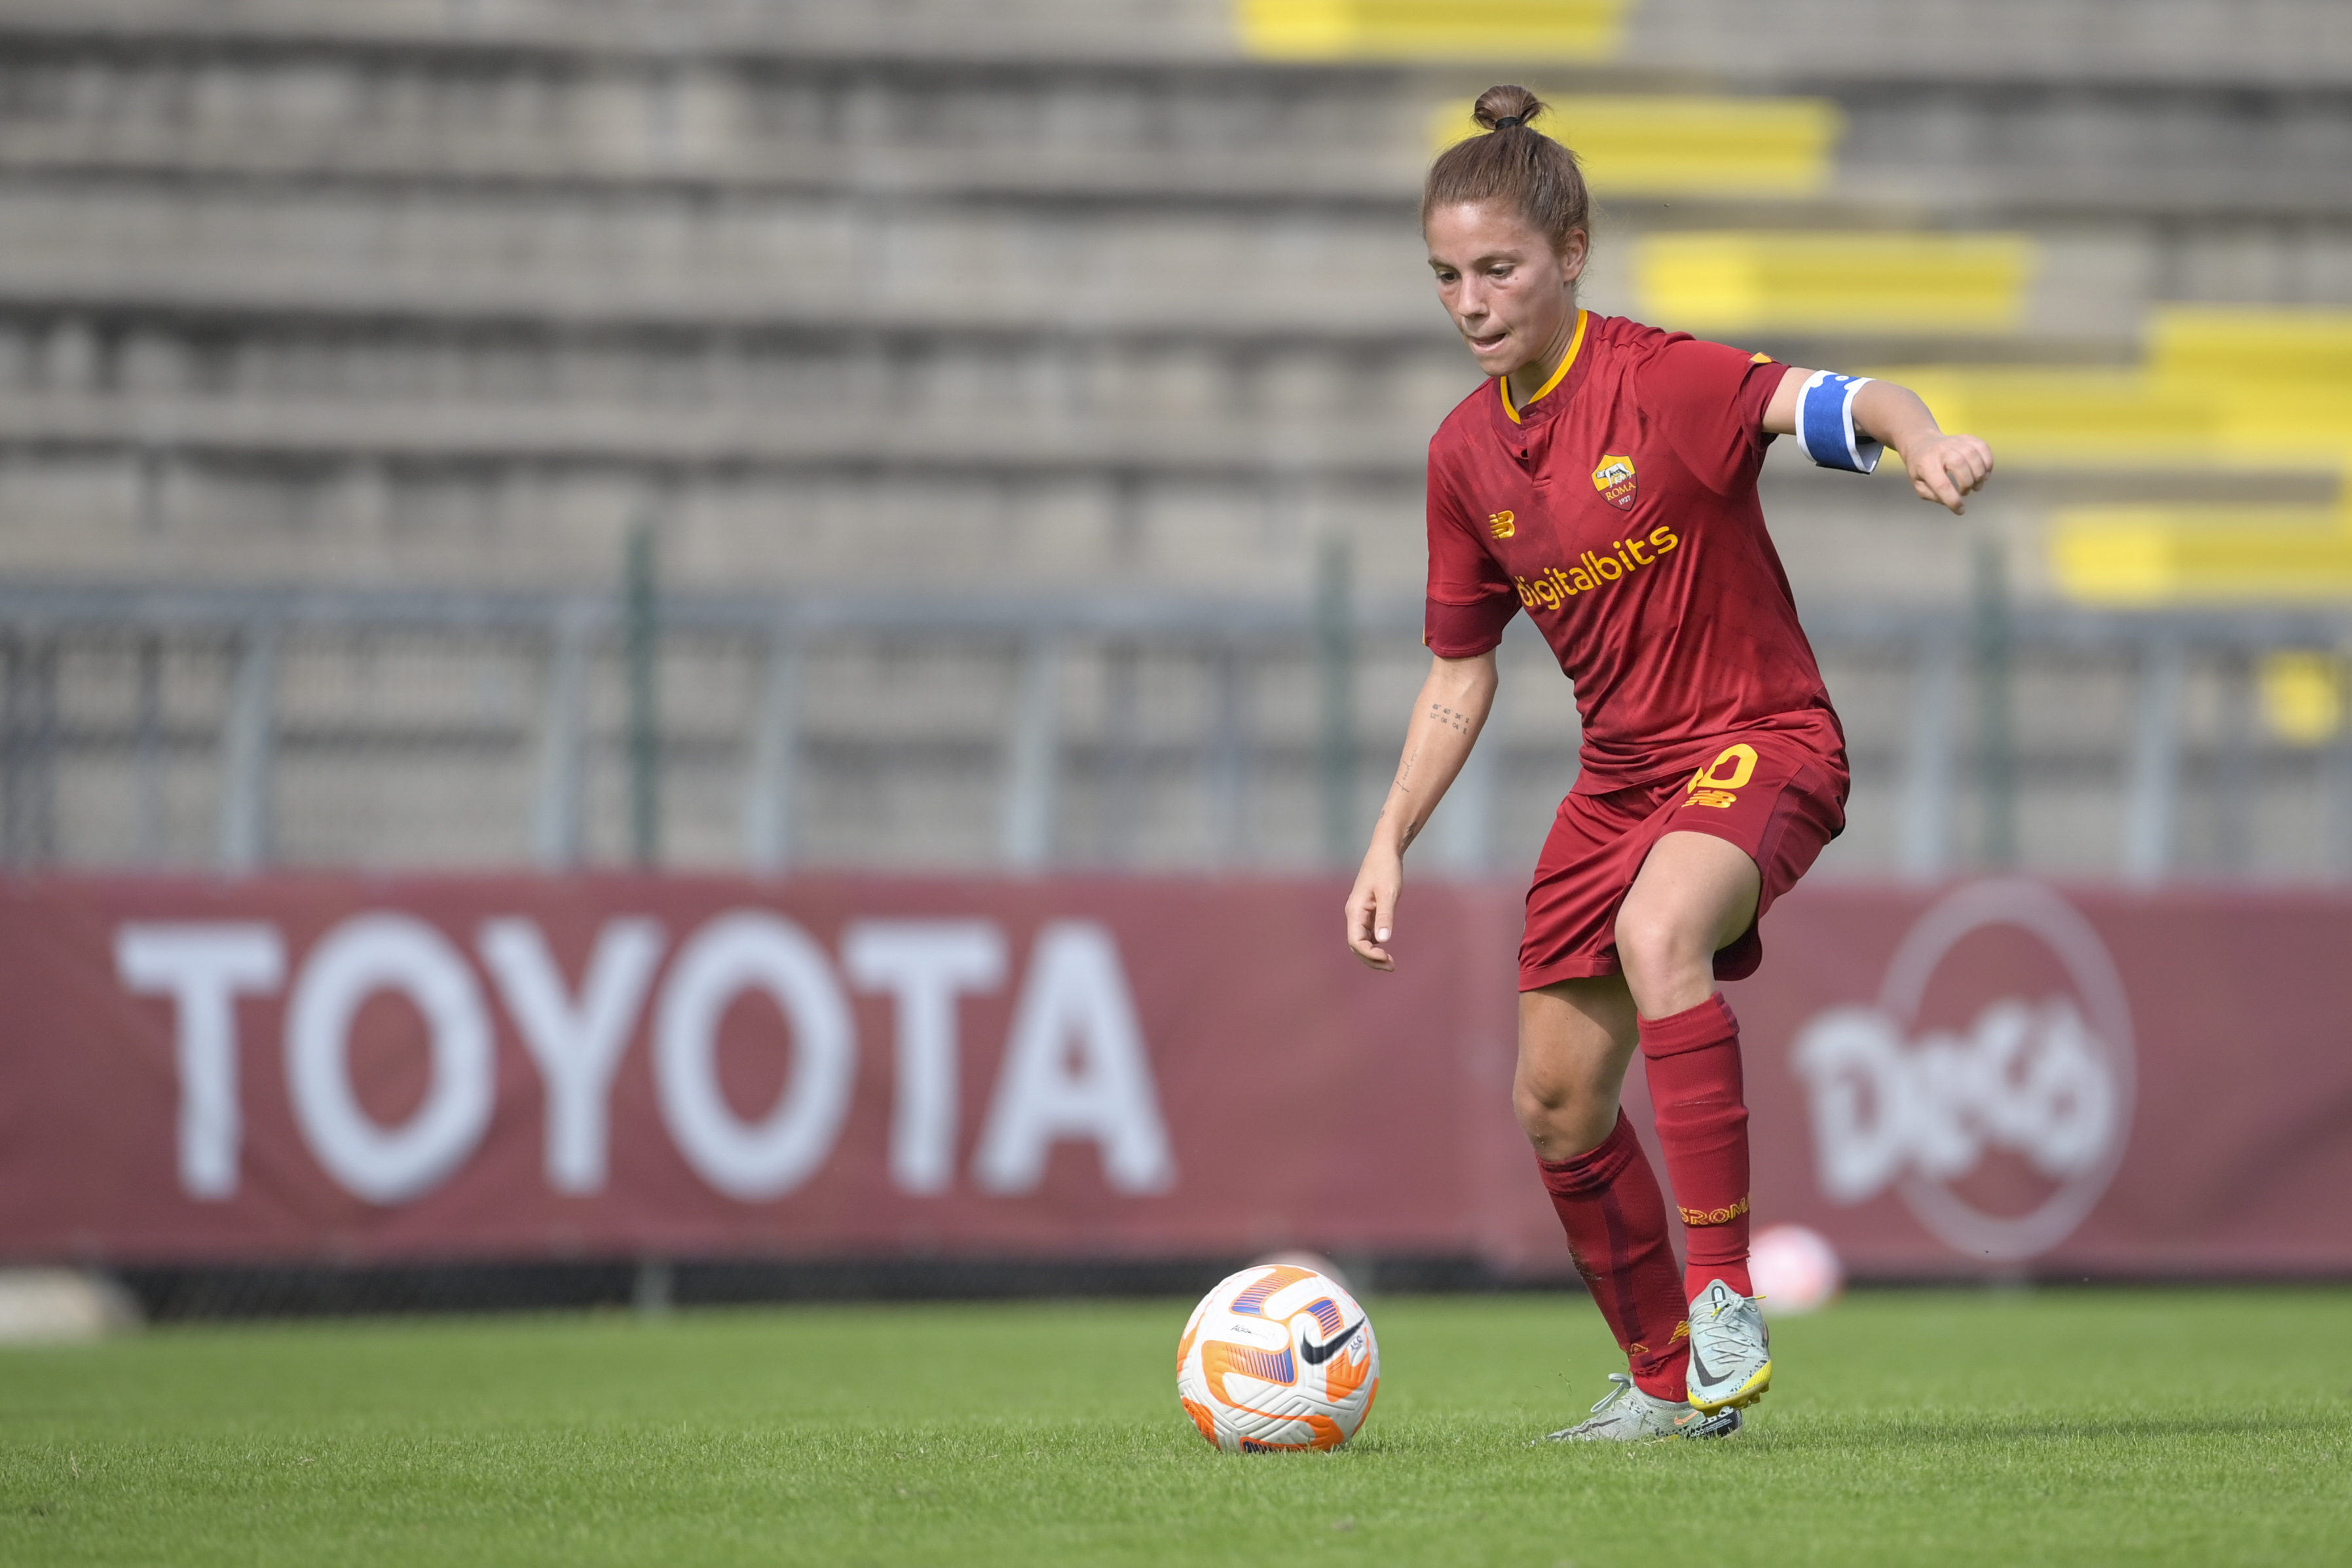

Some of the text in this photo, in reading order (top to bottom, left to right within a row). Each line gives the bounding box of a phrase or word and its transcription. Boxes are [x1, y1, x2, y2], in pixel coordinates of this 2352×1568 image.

[1605, 481, 1636, 501] ROMA
[1618, 495, 1632, 505] 1927
[1515, 526, 1678, 610] digitalbits
[117, 911, 1171, 1201] TOYOTA
